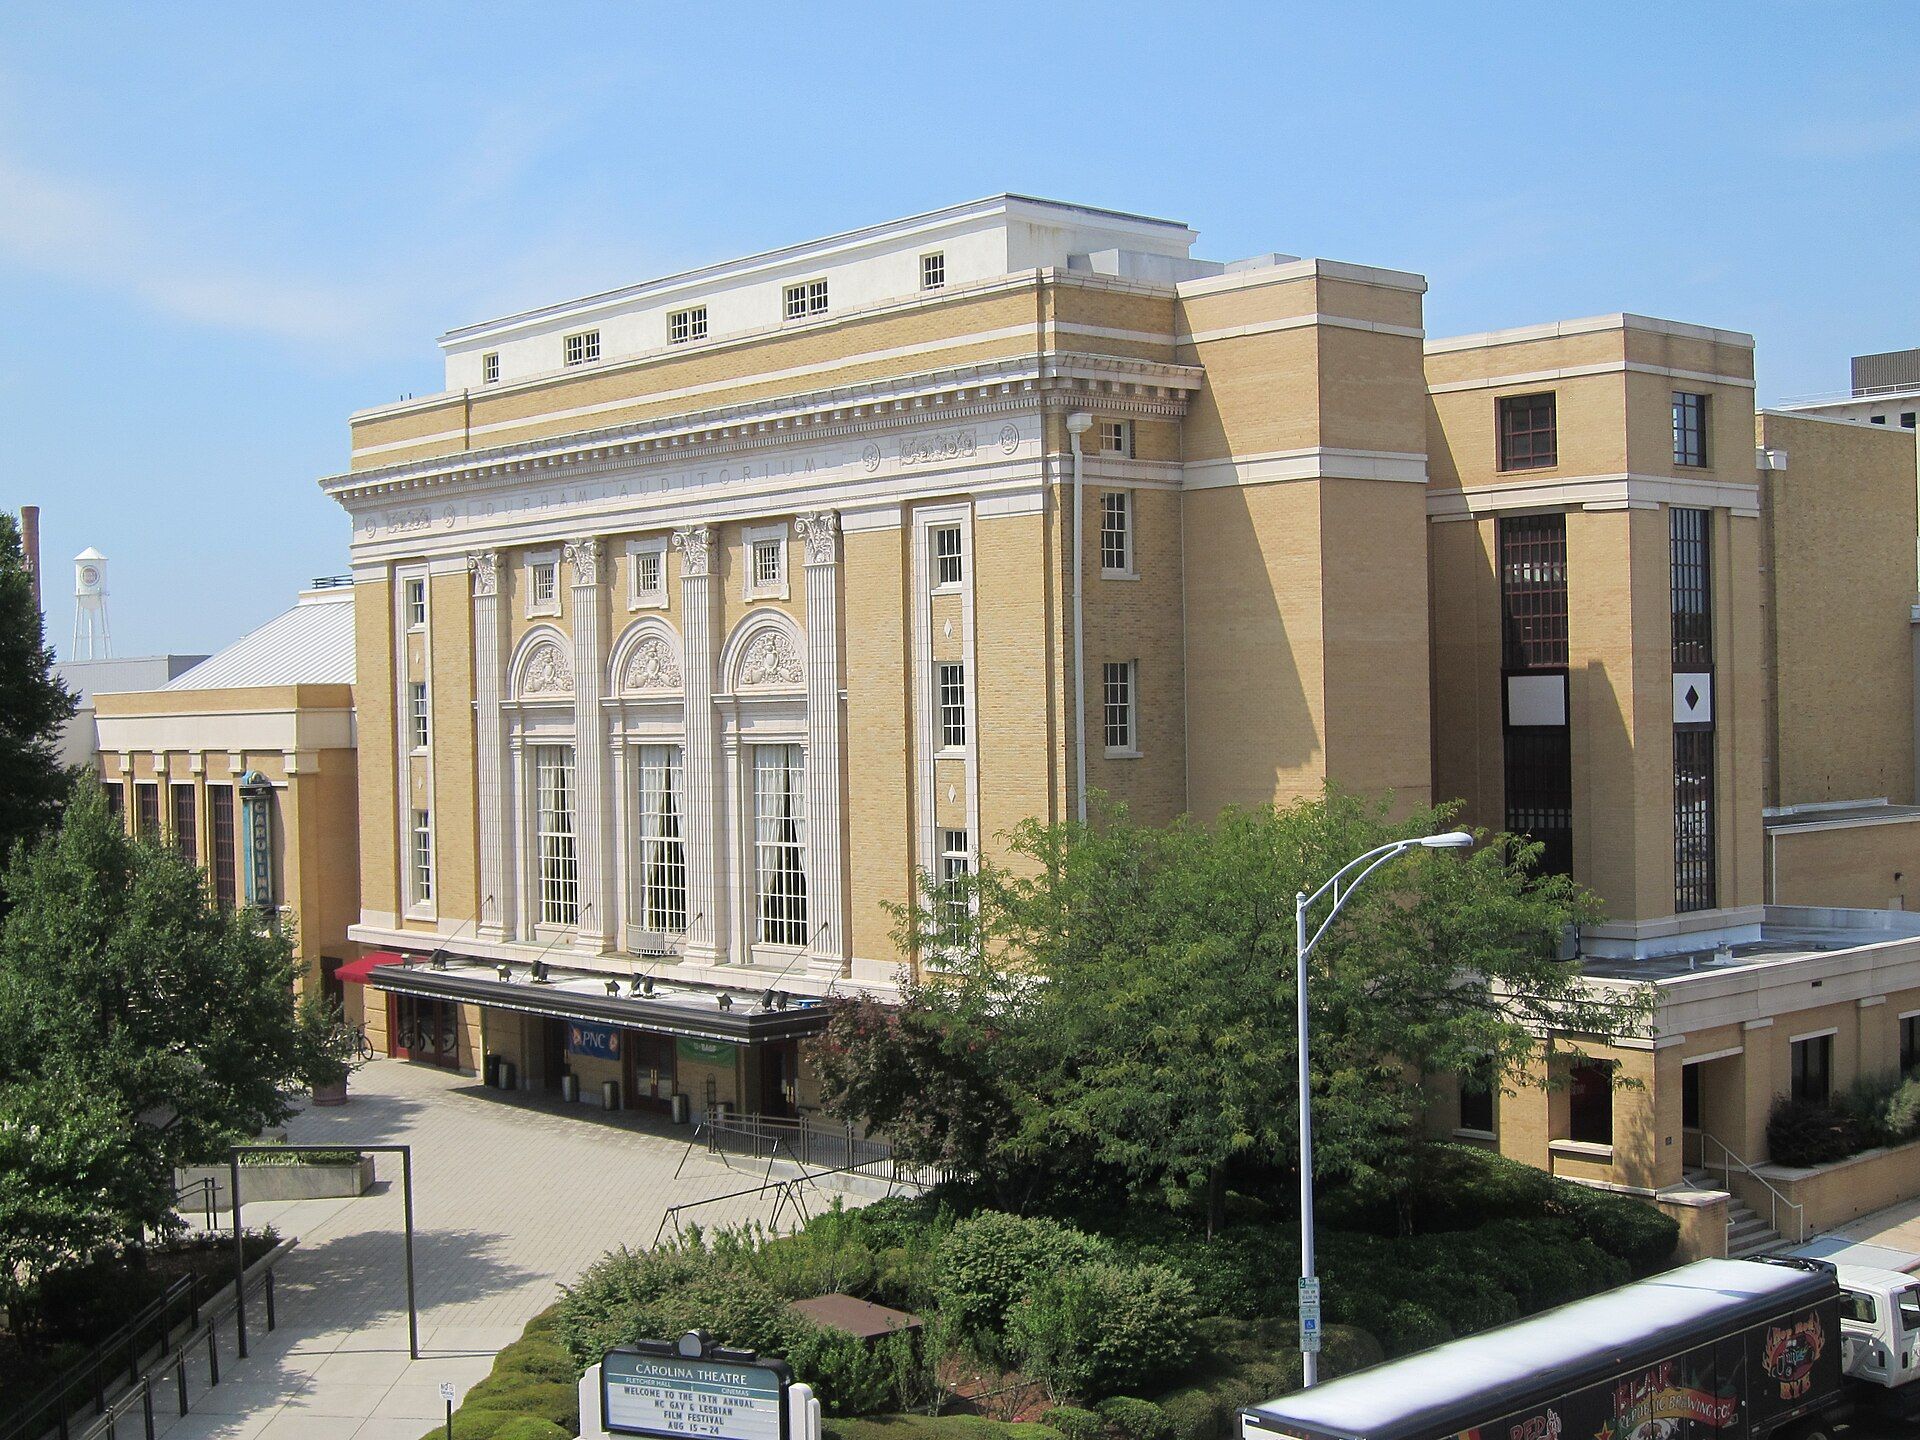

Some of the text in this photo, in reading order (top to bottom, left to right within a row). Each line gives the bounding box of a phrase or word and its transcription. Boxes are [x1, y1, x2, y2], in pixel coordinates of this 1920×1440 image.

[486, 458, 818, 517] DURHAM AUDITORIUM
[254, 801, 268, 901] CAROLINA
[582, 1031, 606, 1049] PNC
[625, 1377, 672, 1388] FLETCHER HALL
[635, 1363, 748, 1385] CAROLINA THEATRE
[624, 1386, 754, 1409] WELCOME TO THE 19TH ANNUAL
[721, 1387, 749, 1396] CINEMAS
[654, 1400, 665, 1409] NC
[668, 1401, 685, 1411] GAY
[699, 1404, 733, 1417] LESBIAN
[1668, 1394, 1713, 1418] BREWING
[663, 1410, 724, 1426] FILM FESTIVAL
[668, 1421, 684, 1431] AUG
